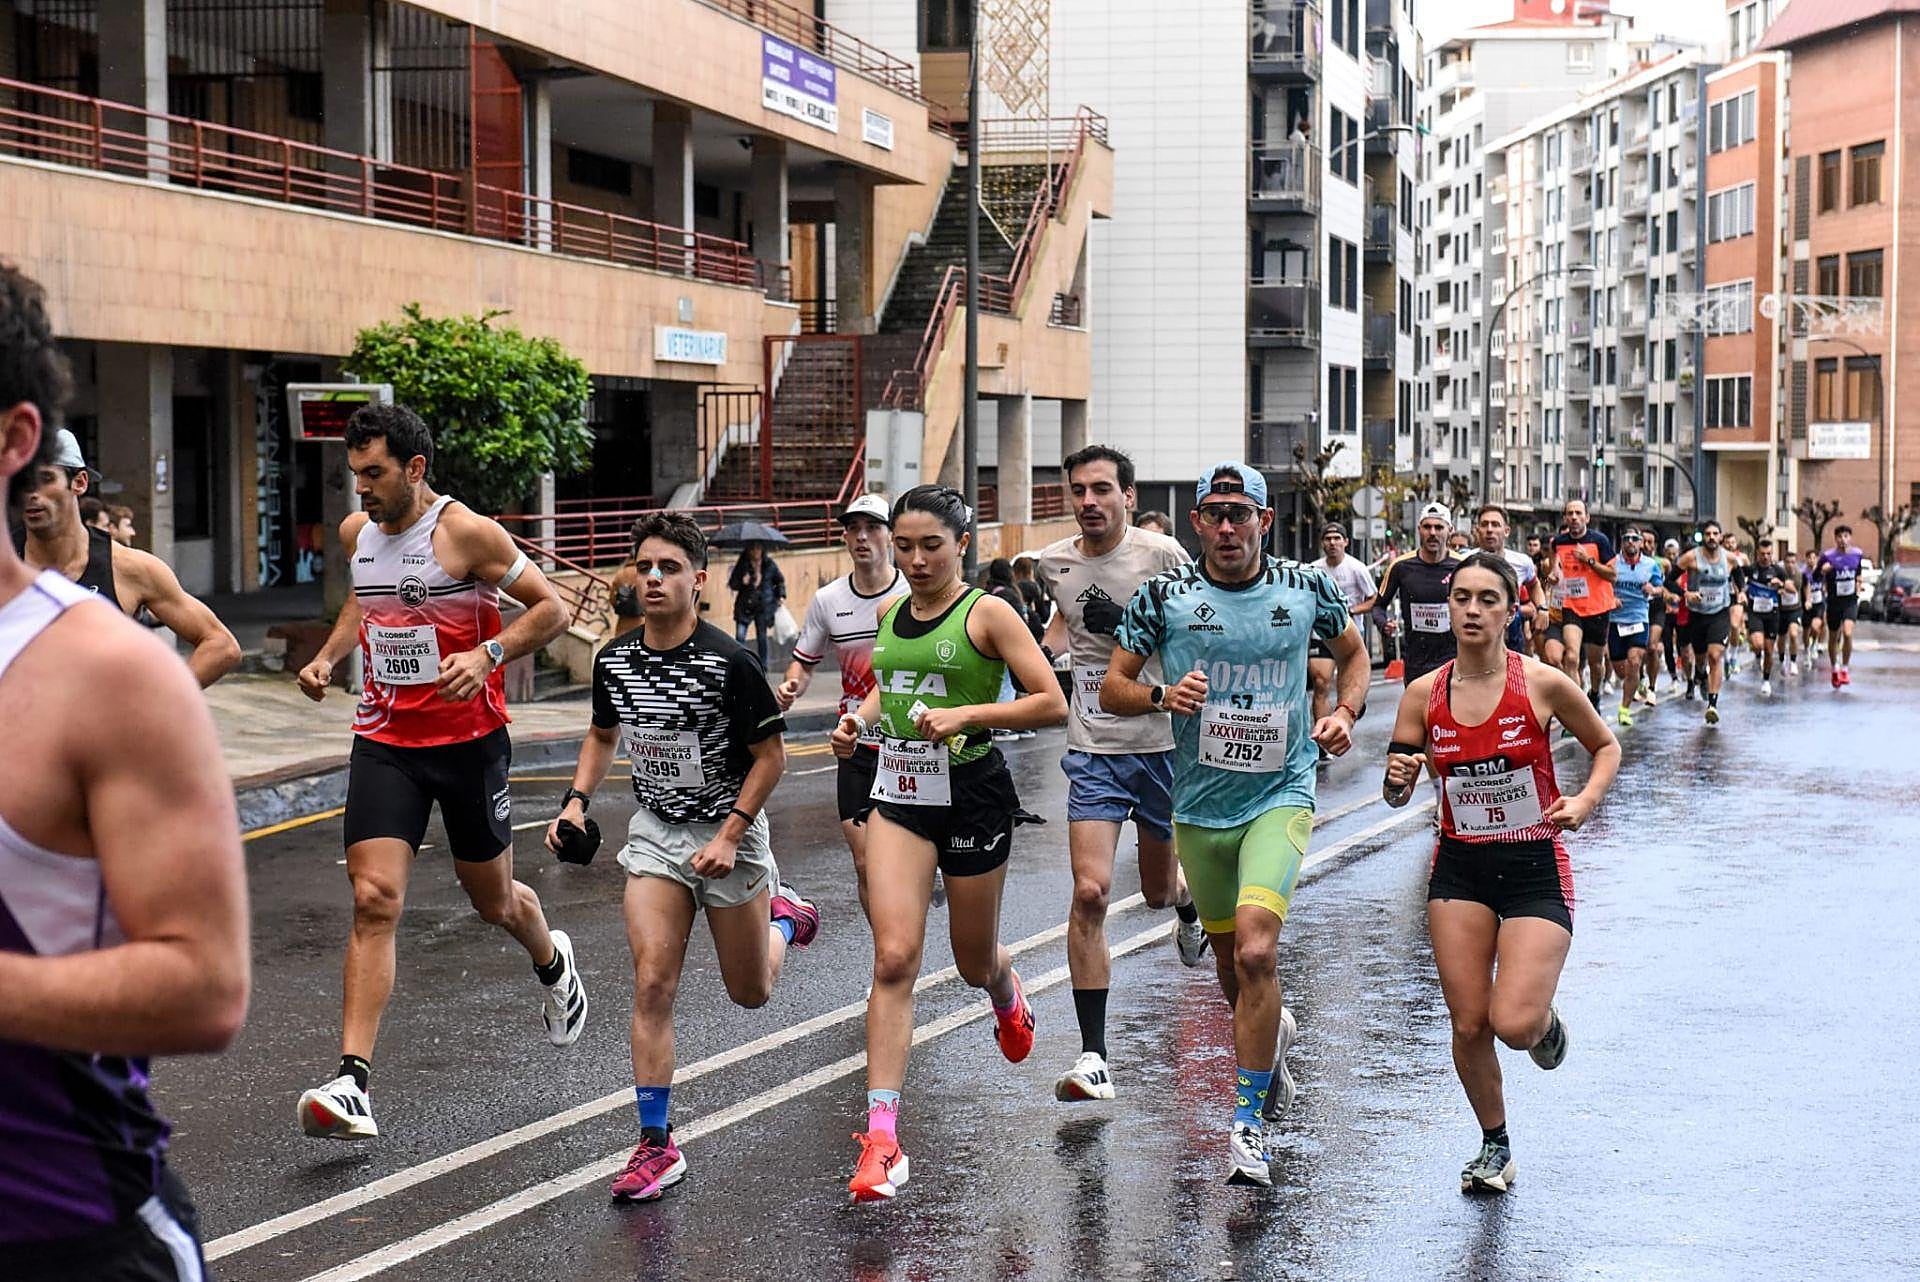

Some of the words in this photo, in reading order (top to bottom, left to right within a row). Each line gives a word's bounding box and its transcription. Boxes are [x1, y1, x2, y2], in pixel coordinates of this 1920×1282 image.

[1188, 624, 1224, 632] FORTUNA
[384, 658, 420, 674] 2609
[1231, 713, 1269, 723] CORREO
[643, 733, 678, 741] CORREO
[893, 745, 926, 754] CORREO
[1224, 742, 1263, 761] 2752
[658, 752, 692, 760] BILBAO
[643, 759, 681, 777] 2595
[1214, 757, 1252, 768] kutxabank
[1474, 759, 1505, 776] BM
[898, 775, 917, 793] 84
[1474, 777, 1512, 788] CORREO
[1492, 785, 1526, 797] SANTURCE
[1492, 791, 1528, 804] BILBAO
[1485, 807, 1506, 823] 75
[951, 836, 975, 848] Vital
